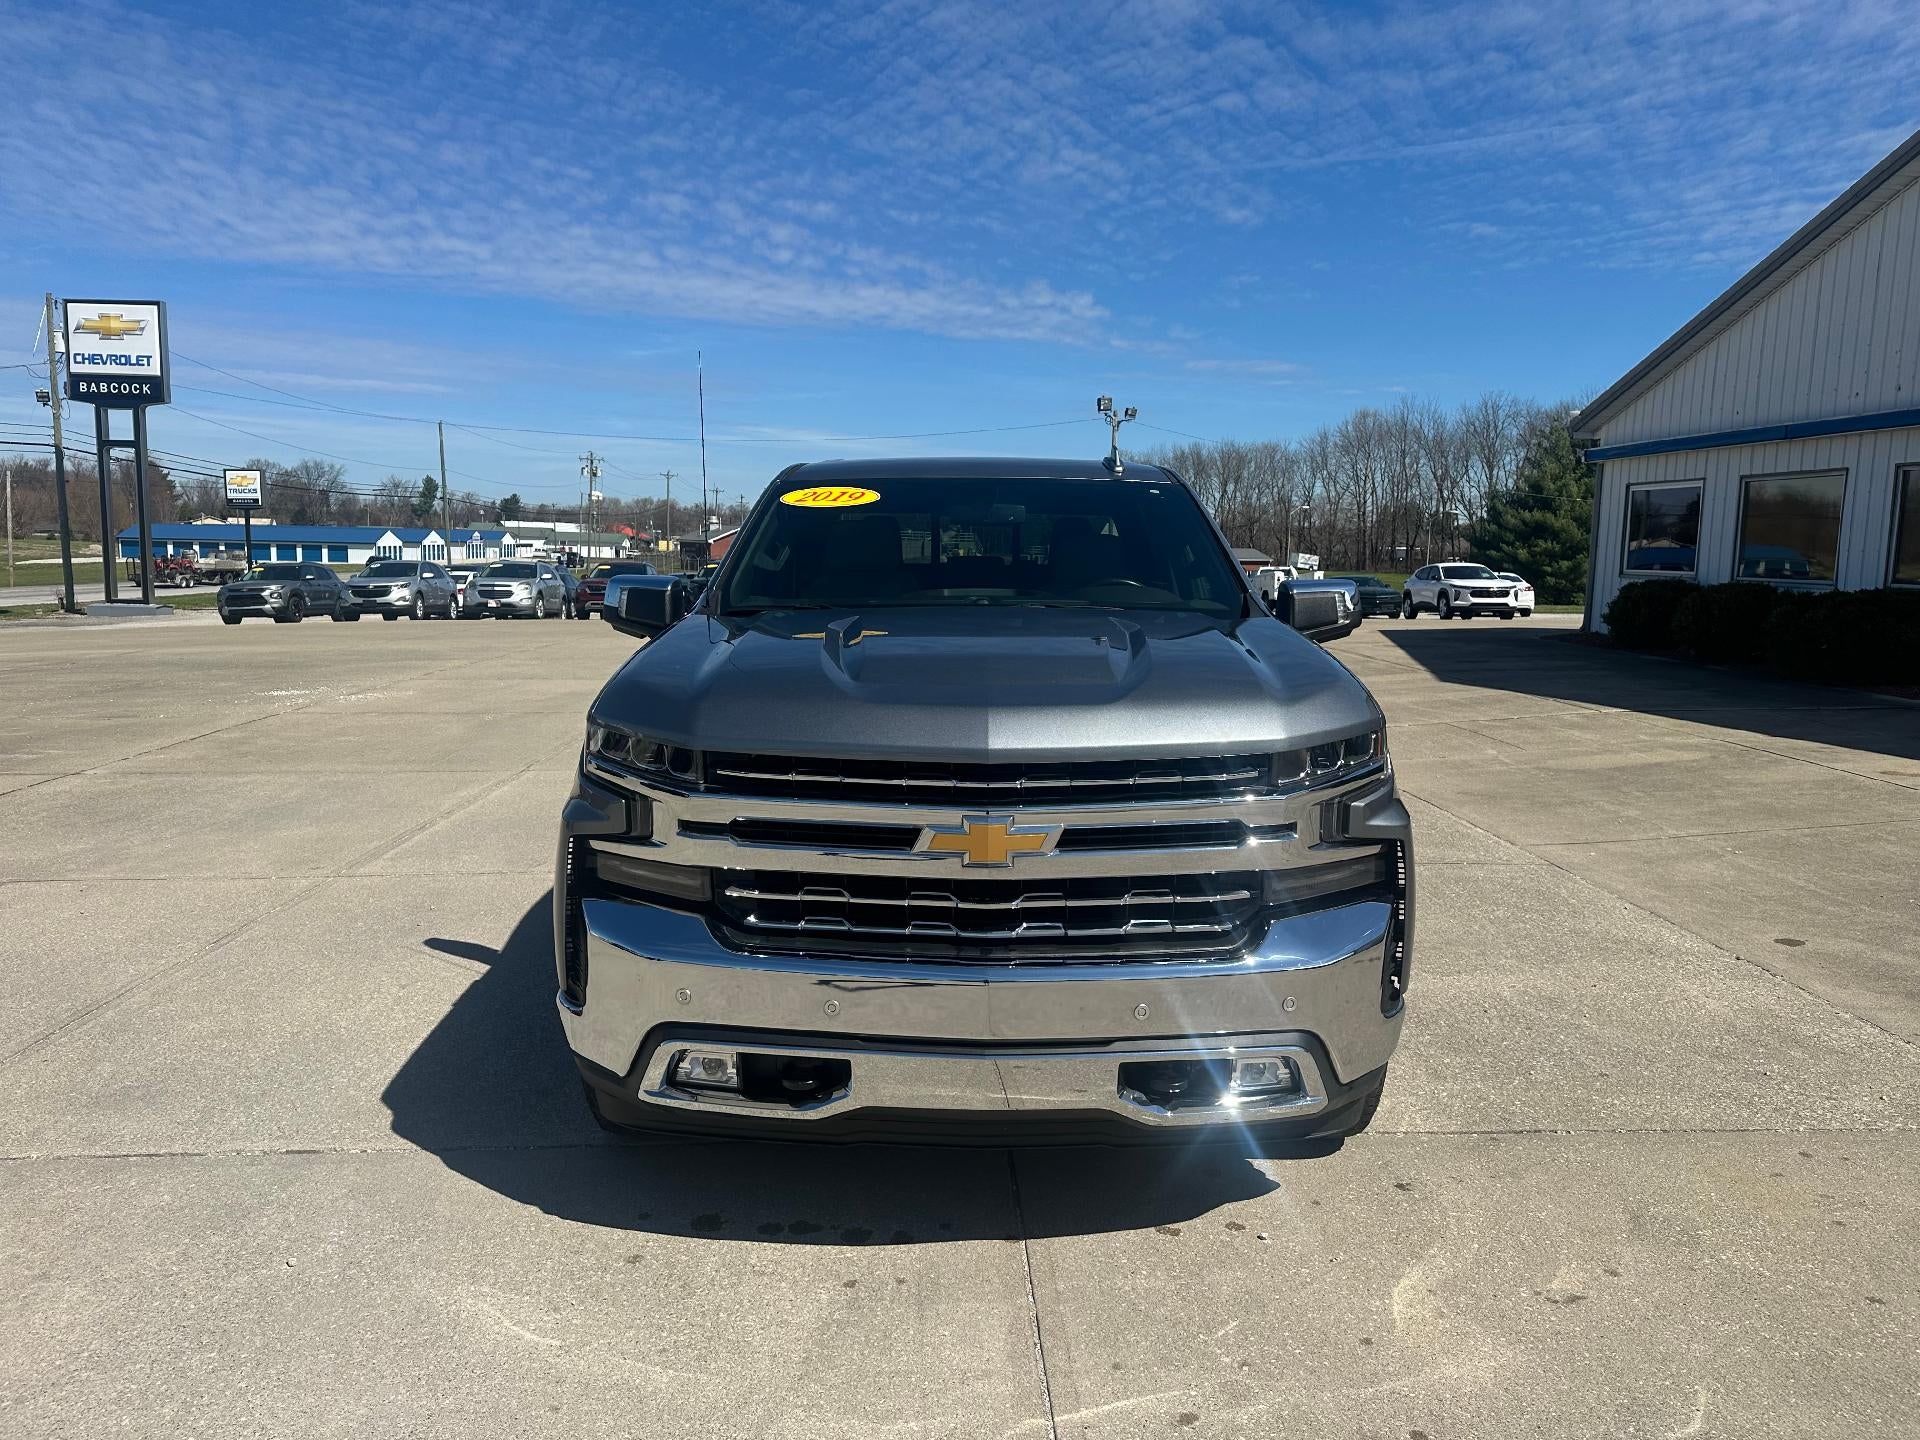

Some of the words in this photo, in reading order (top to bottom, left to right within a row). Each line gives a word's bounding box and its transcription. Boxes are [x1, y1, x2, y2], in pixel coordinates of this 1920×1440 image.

[73, 353, 152, 367] CHEVROLET
[79, 381, 151, 394] BABCOCK
[228, 487, 258, 495] TRUCKS
[793, 491, 866, 503] 2019
